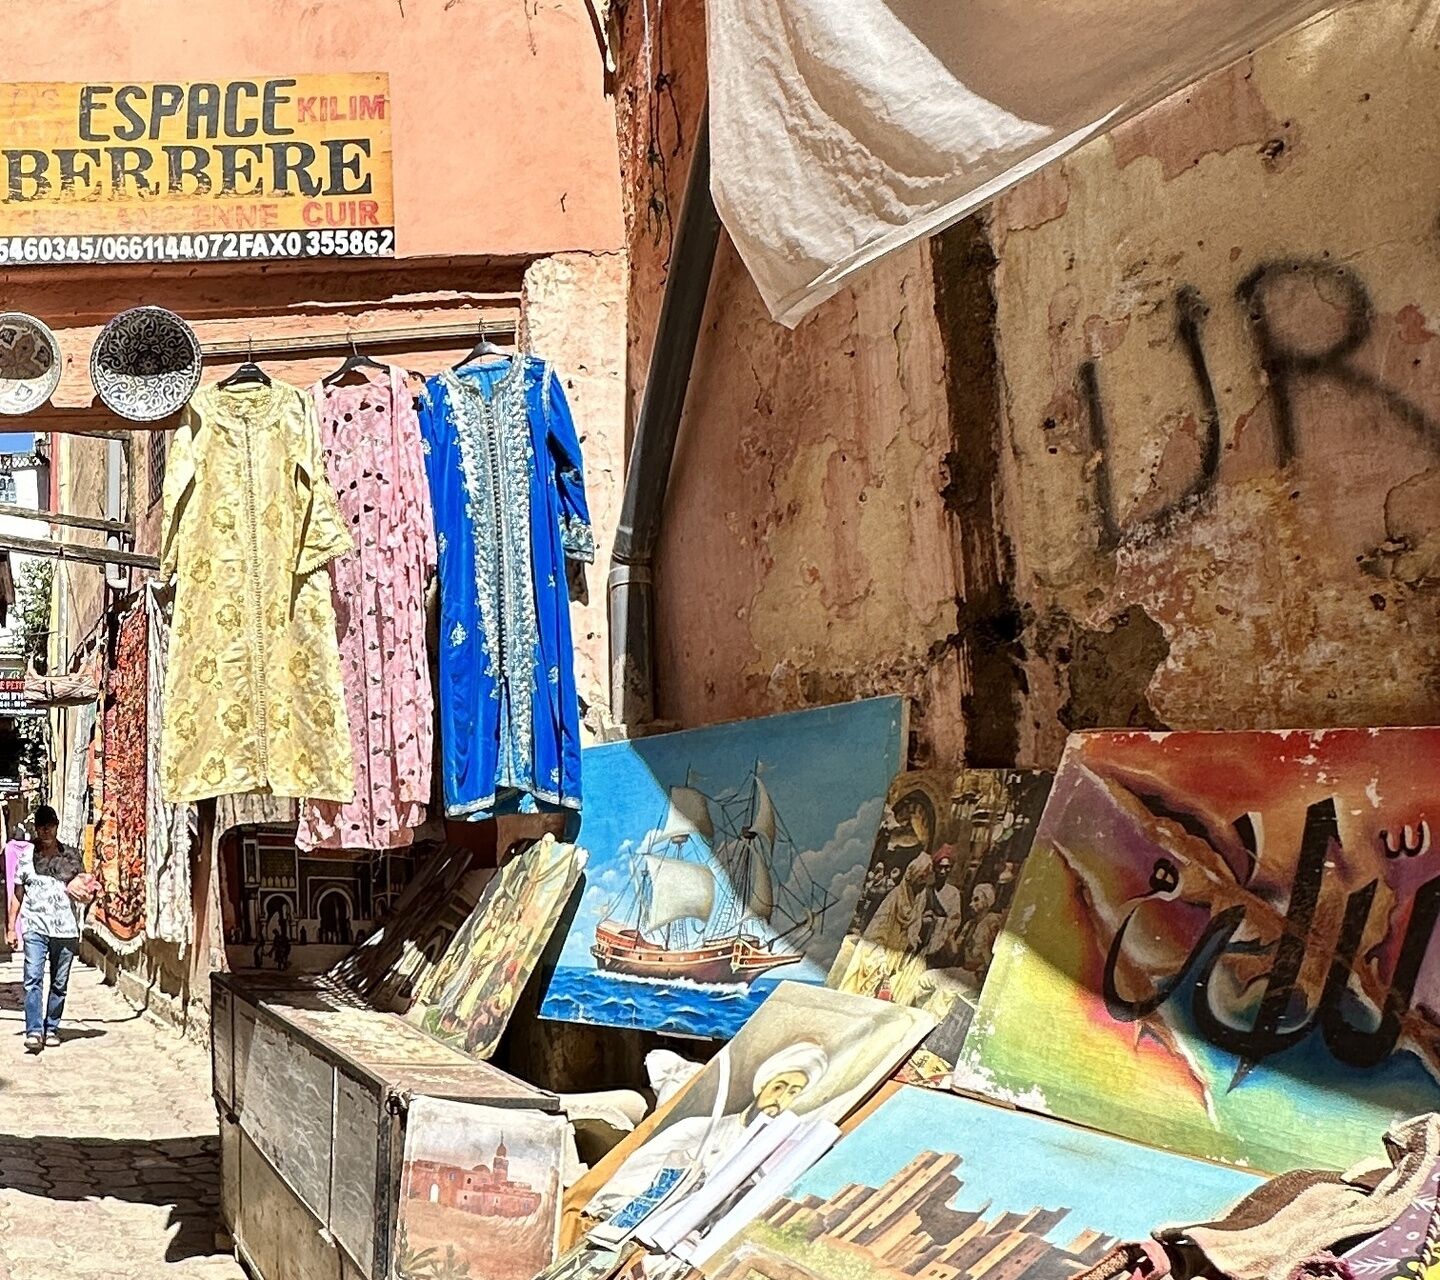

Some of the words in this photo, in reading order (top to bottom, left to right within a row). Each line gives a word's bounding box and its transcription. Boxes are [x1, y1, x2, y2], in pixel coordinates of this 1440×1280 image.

[78, 79, 297, 143] ESPACE
[297, 94, 386, 123] KILIM
[1, 138, 372, 204] BERBERE
[303, 199, 380, 227] CUIR
